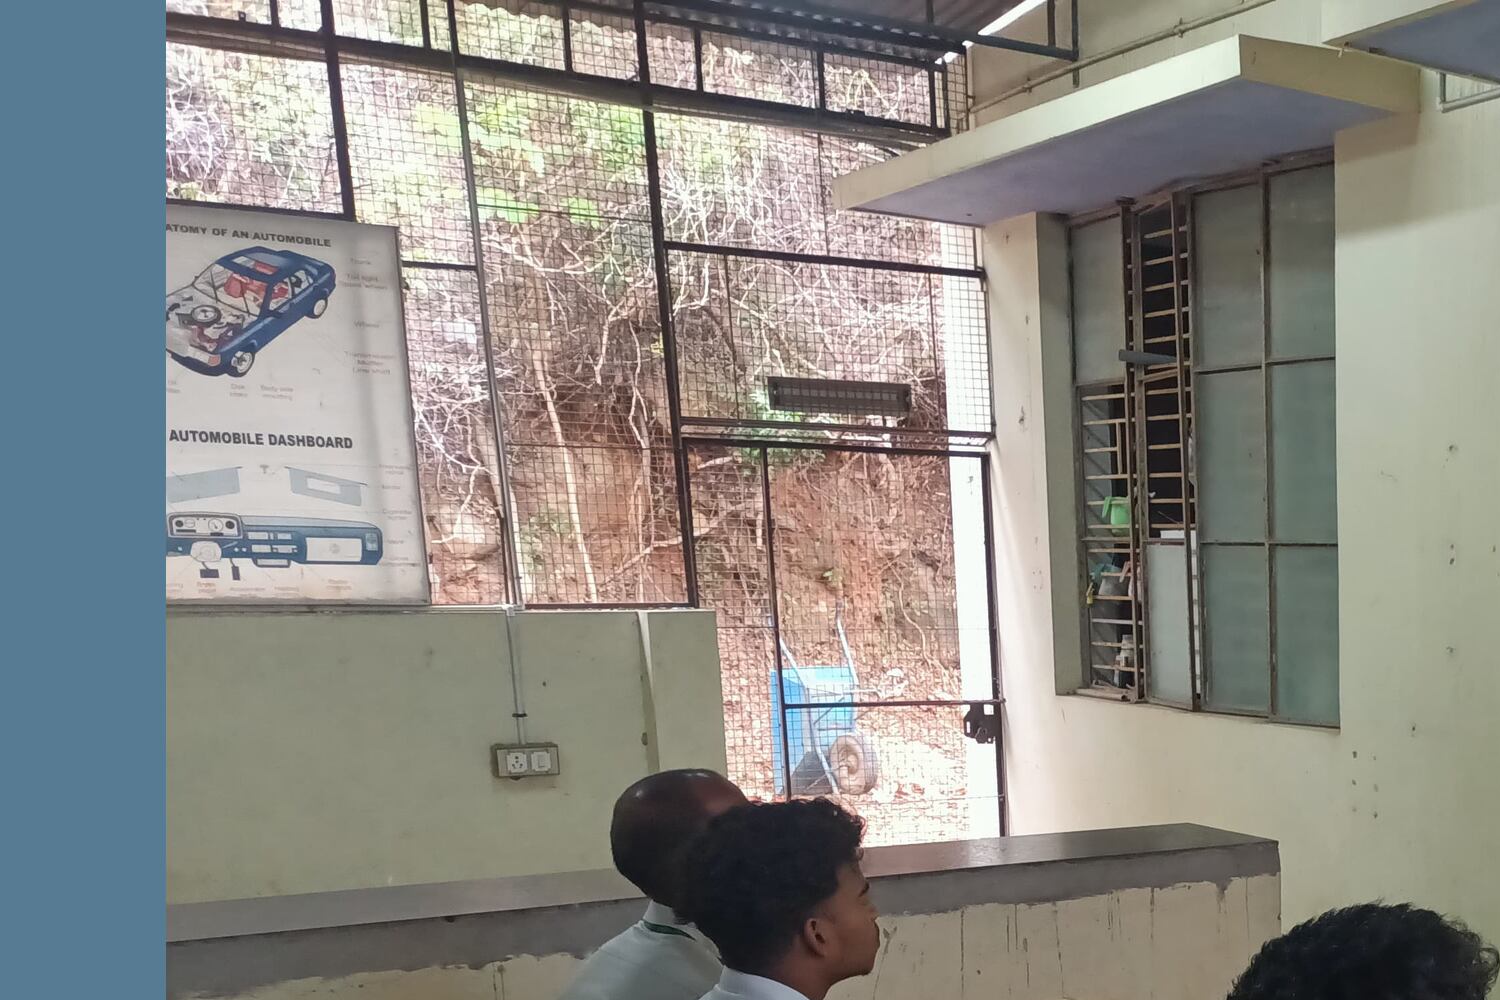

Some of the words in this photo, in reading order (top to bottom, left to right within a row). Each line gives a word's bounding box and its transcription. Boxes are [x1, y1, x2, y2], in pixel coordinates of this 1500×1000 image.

[212, 227, 227, 237] OF
[231, 230, 250, 239] AN
[252, 232, 332, 247] AUTOMOBILE
[169, 429, 264, 446] AUTOMOBILE
[268, 433, 353, 449] DASHBOARD
